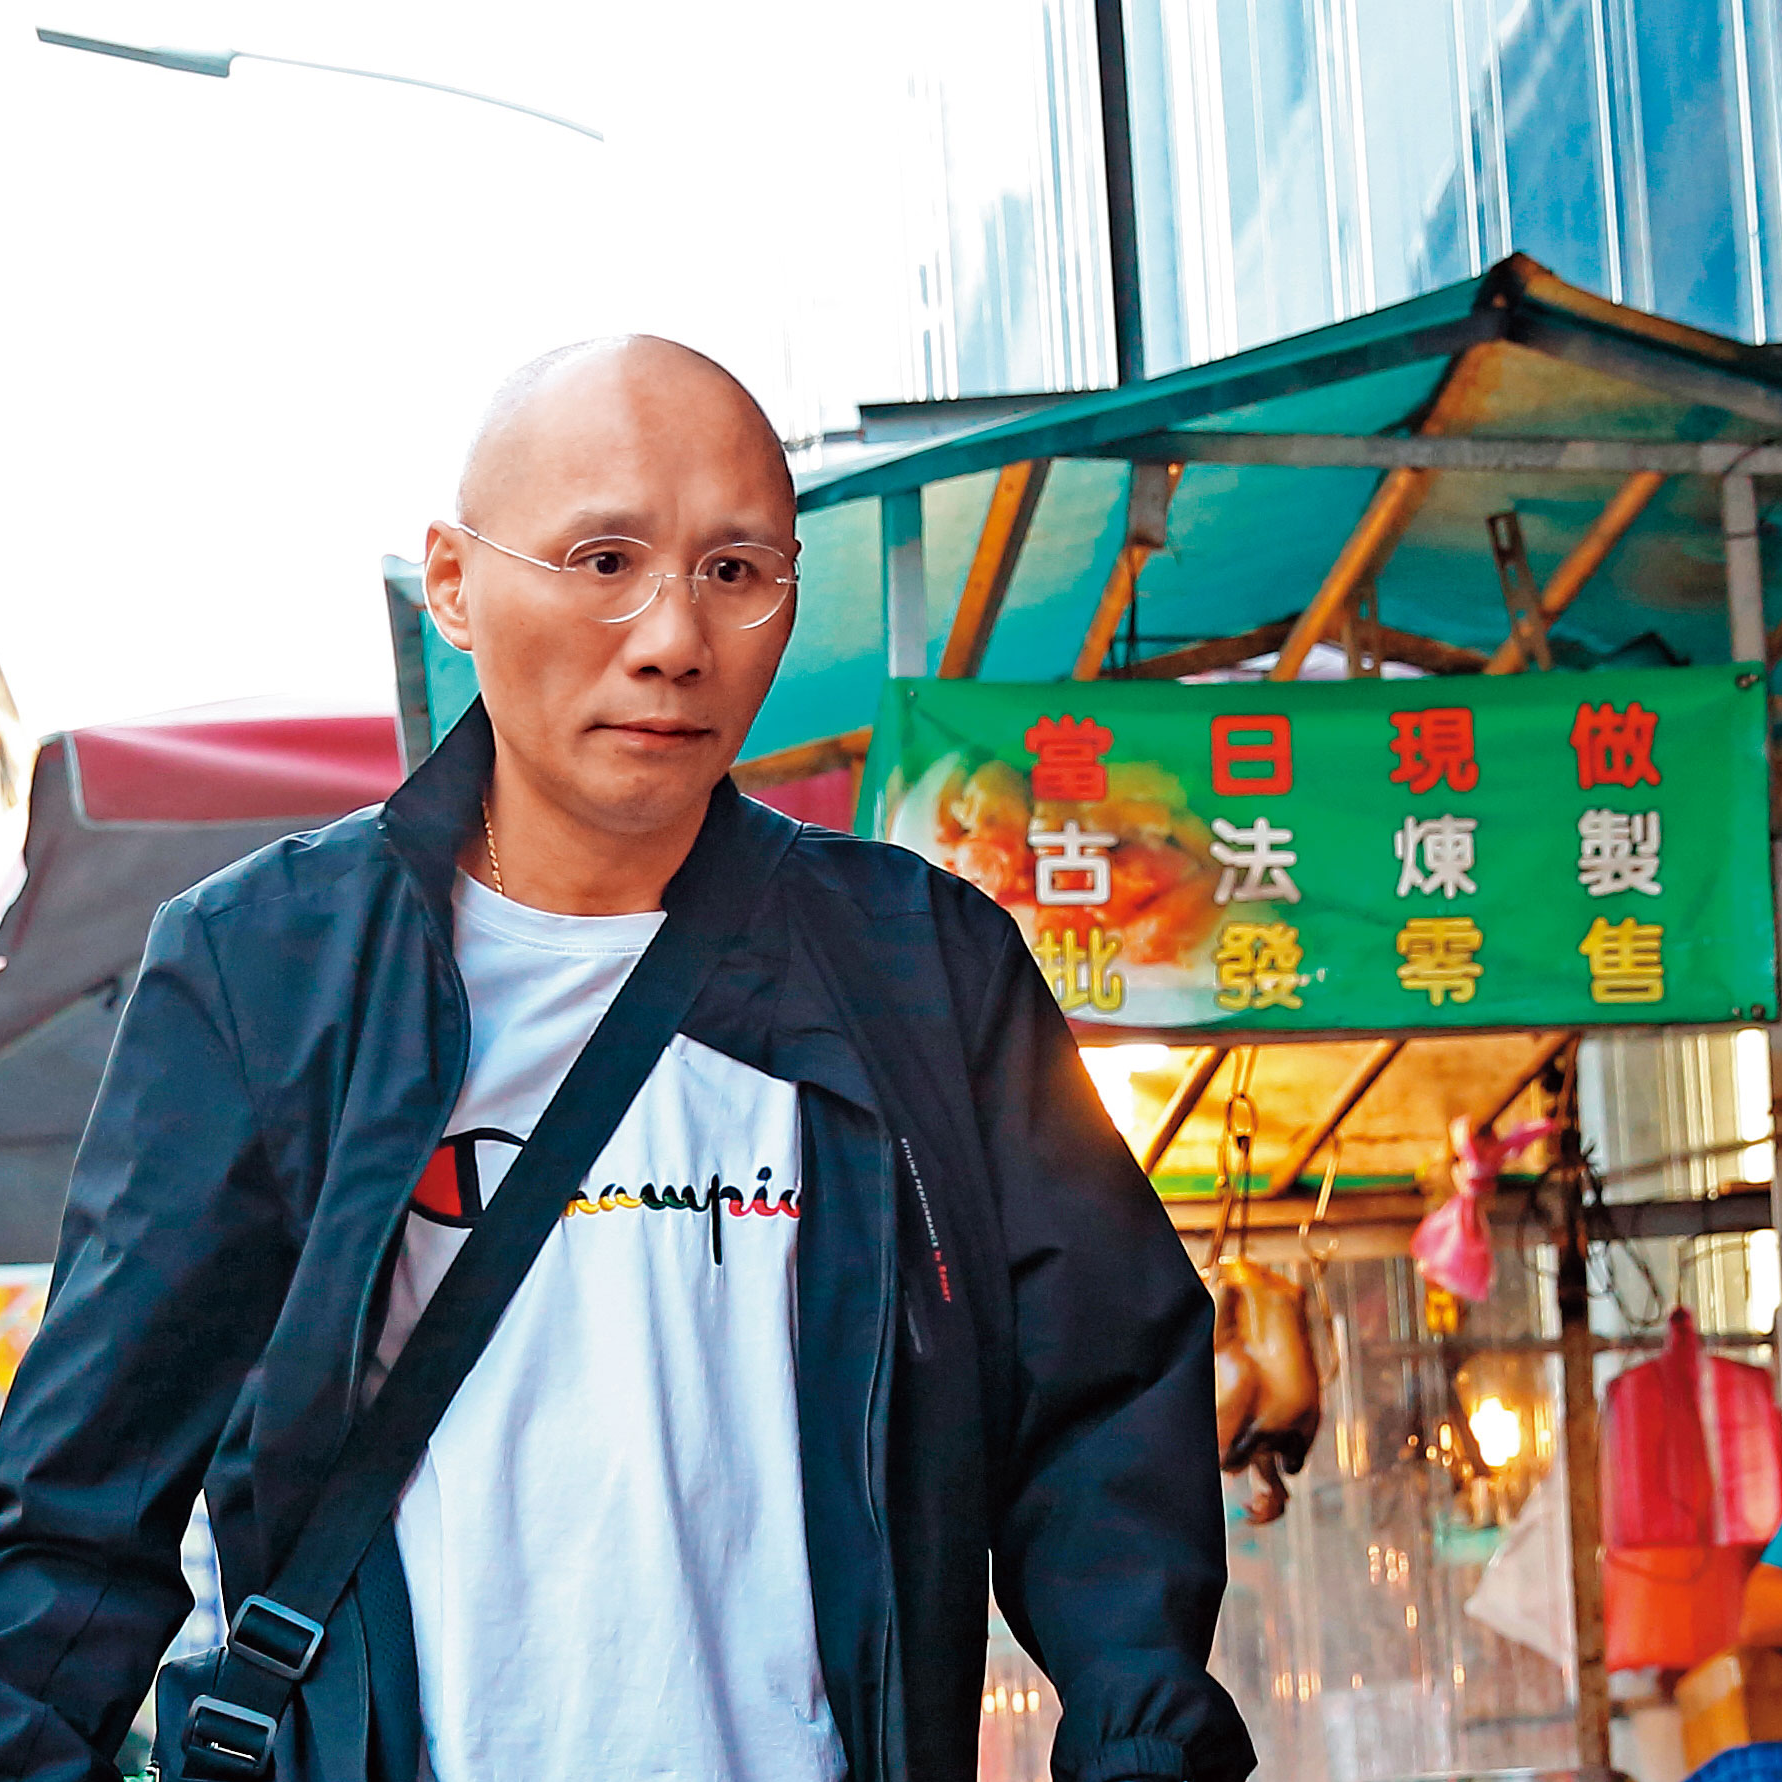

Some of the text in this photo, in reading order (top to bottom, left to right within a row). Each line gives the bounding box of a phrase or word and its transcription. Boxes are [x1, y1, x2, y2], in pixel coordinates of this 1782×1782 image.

[1024, 702, 1662, 802] 當日現做
[1027, 807, 1662, 905] 古法煉製
[1034, 916, 1665, 1013] 批發零售
